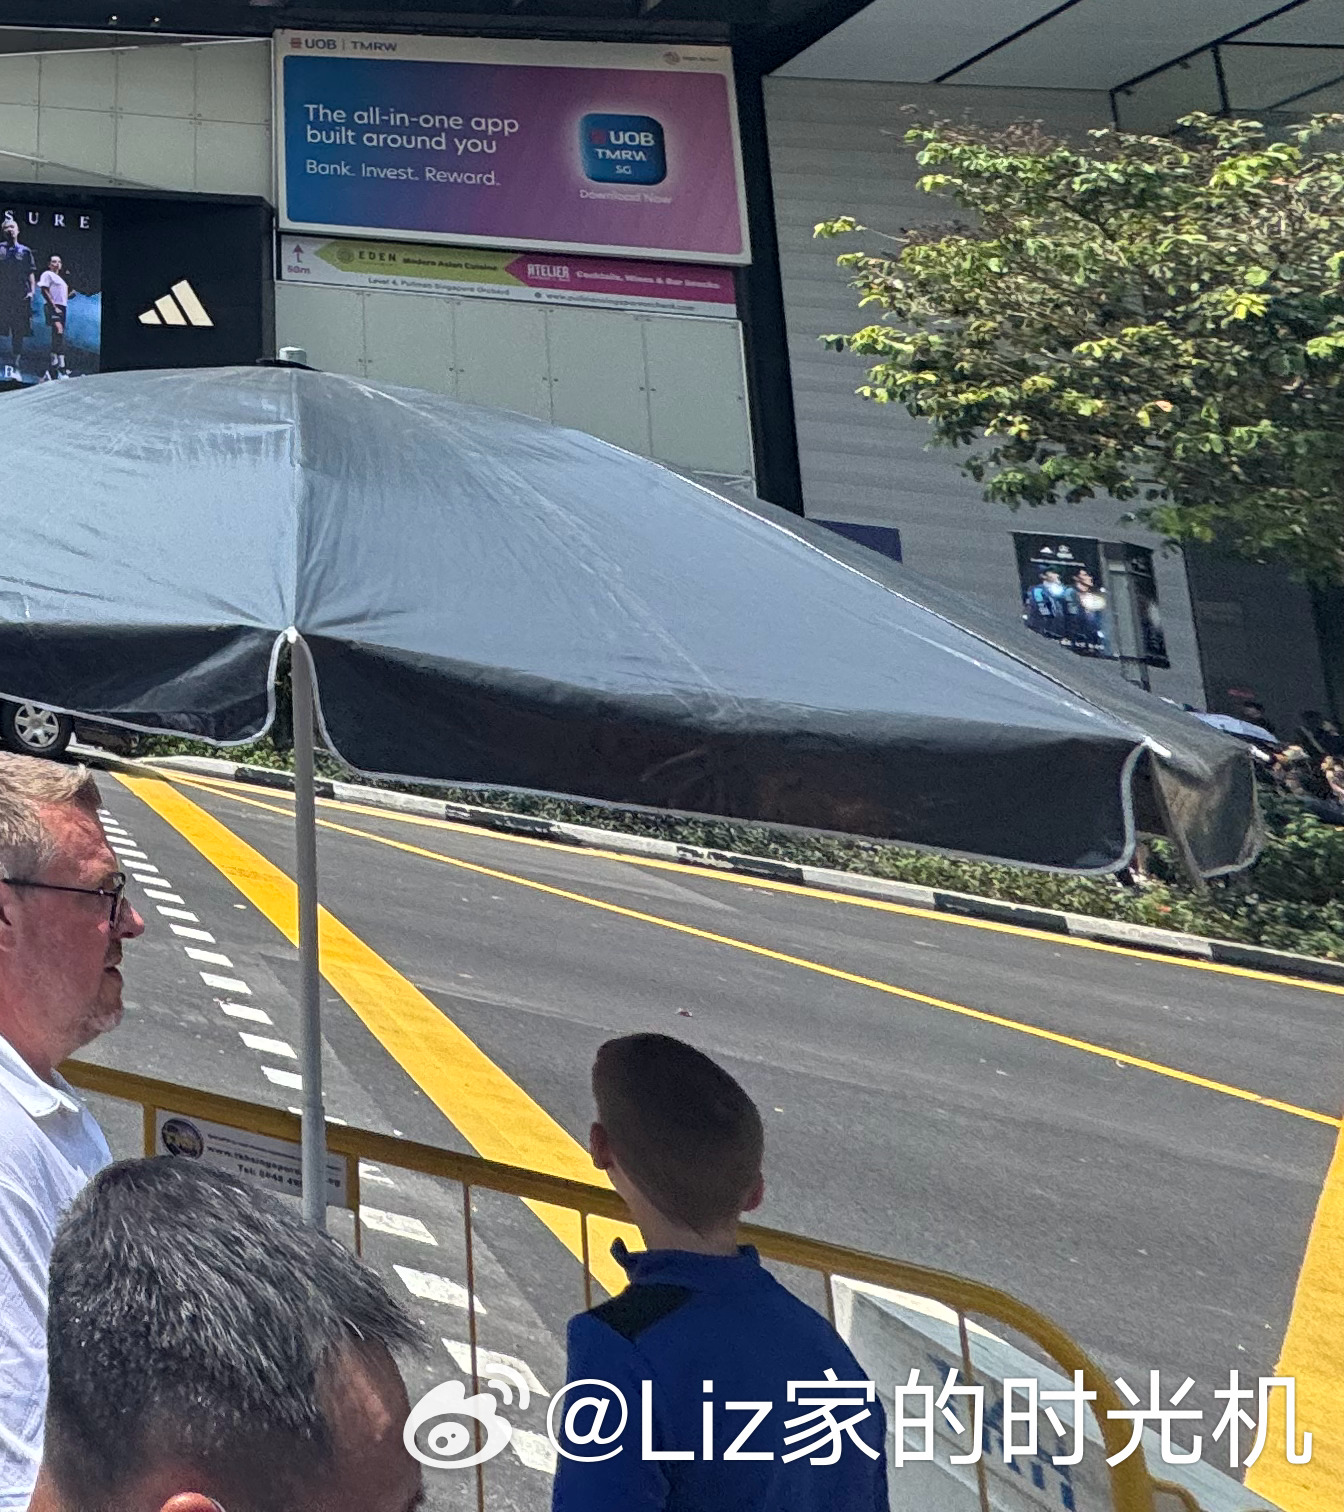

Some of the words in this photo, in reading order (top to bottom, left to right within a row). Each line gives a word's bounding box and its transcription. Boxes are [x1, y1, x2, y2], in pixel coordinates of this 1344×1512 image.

[304, 39, 337, 50] UOB
[351, 40, 398, 52] TMRW
[304, 104, 347, 123] The
[354, 107, 463, 130] all-in-one
[471, 116, 520, 137] app
[307, 125, 357, 146] built
[362, 134, 447, 151] around
[454, 138, 498, 156] you
[610, 131, 655, 147] UOB
[306, 160, 356, 177] Bank.
[361, 164, 419, 181] Invest.
[425, 167, 501, 186] Reward.
[615, 165, 632, 175] SG
[358, 250, 397, 263] EDEN
